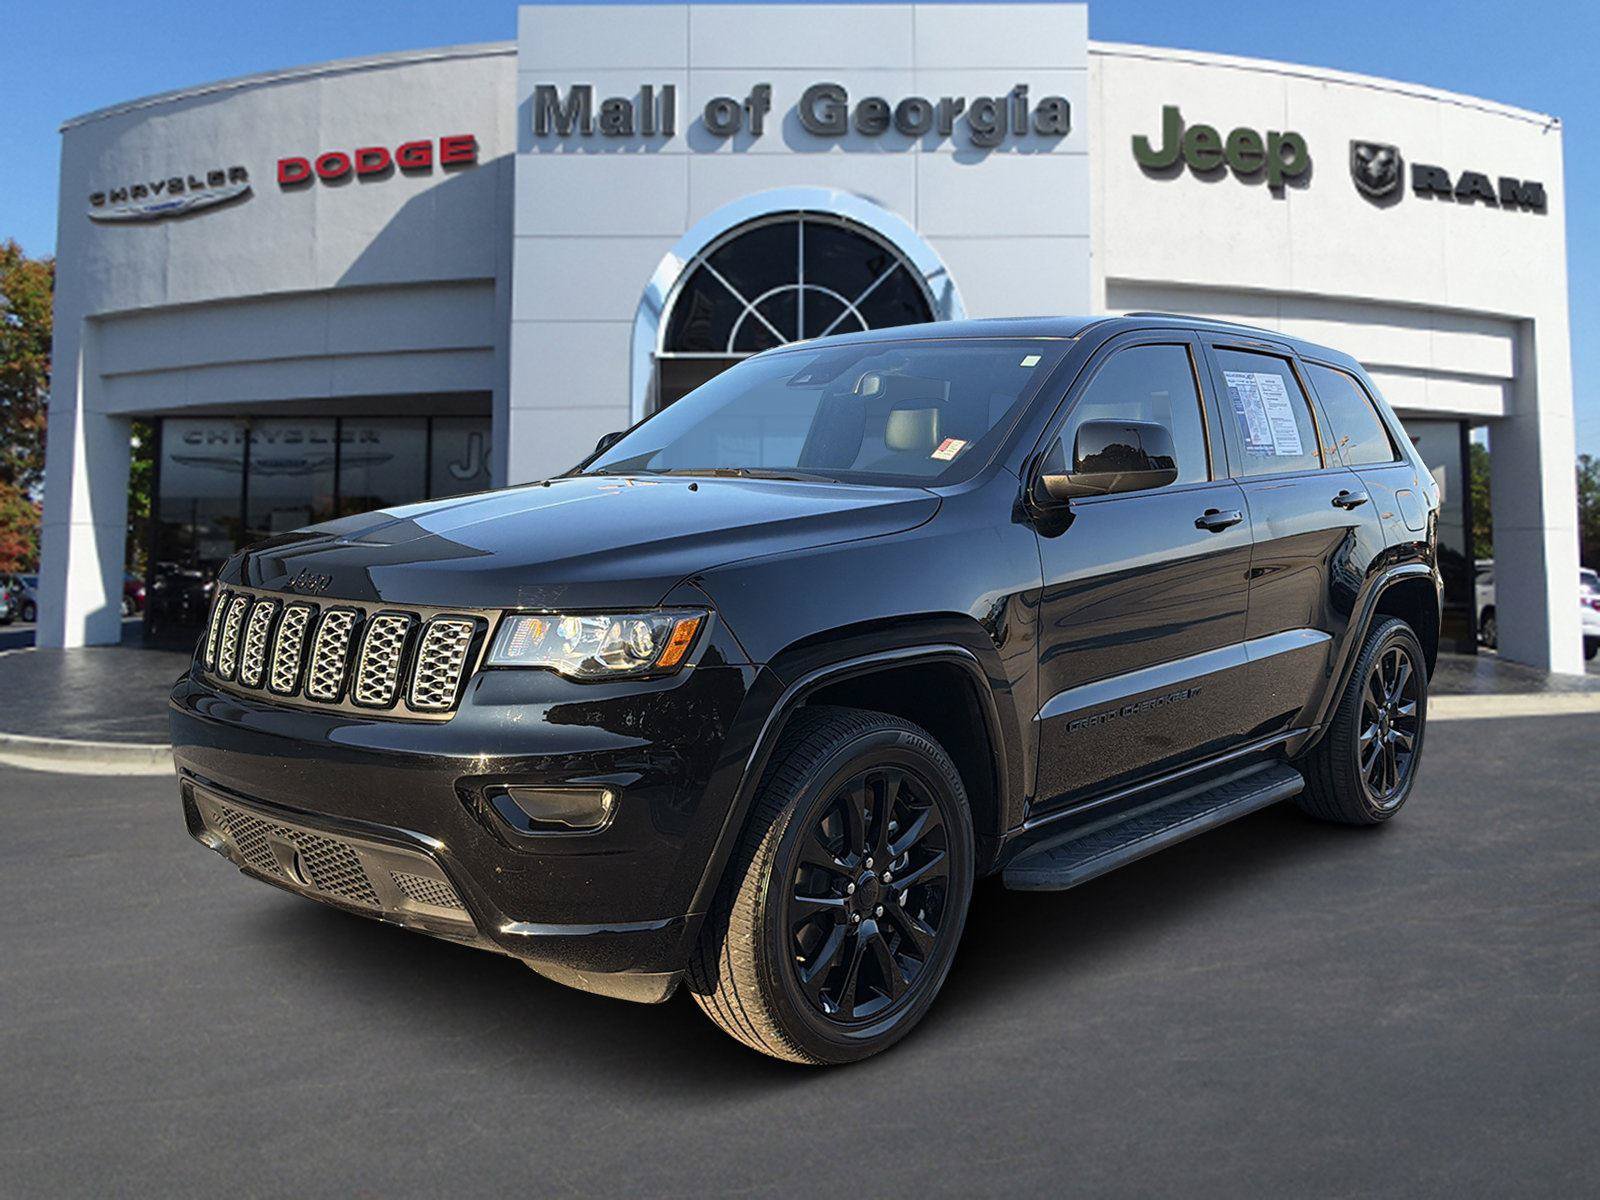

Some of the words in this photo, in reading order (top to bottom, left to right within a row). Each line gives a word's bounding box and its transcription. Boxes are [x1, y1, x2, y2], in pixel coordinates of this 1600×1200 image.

[533, 84, 676, 137] Mall
[703, 83, 772, 137] of
[799, 83, 1072, 147] Georgia
[277, 134, 477, 184] DODGE
[1132, 105, 1308, 188] Jeep
[89, 166, 248, 207] CHRYSLER
[1411, 163, 1548, 212] RAM
